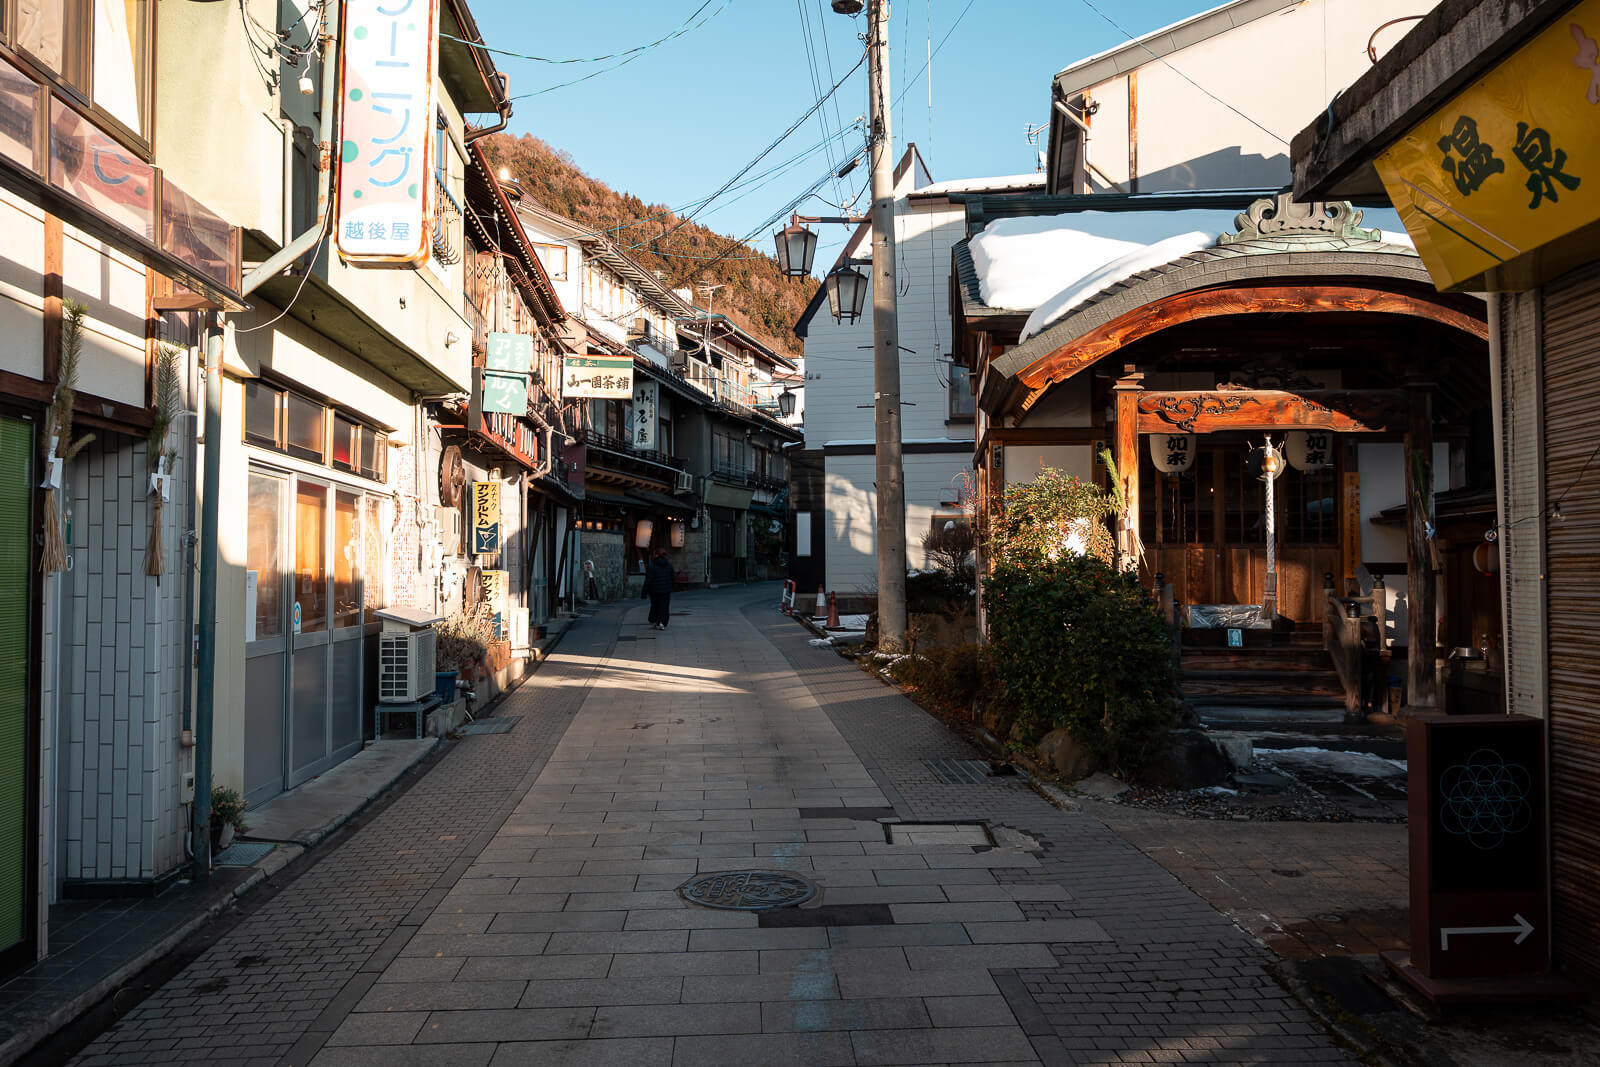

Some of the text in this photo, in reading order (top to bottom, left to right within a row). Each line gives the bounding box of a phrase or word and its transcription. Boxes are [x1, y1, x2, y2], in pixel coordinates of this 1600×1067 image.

[1437, 115, 1581, 209] 温泉
[344, 221, 410, 241] 越後屋
[477, 484, 489, 526] アンクルトム
